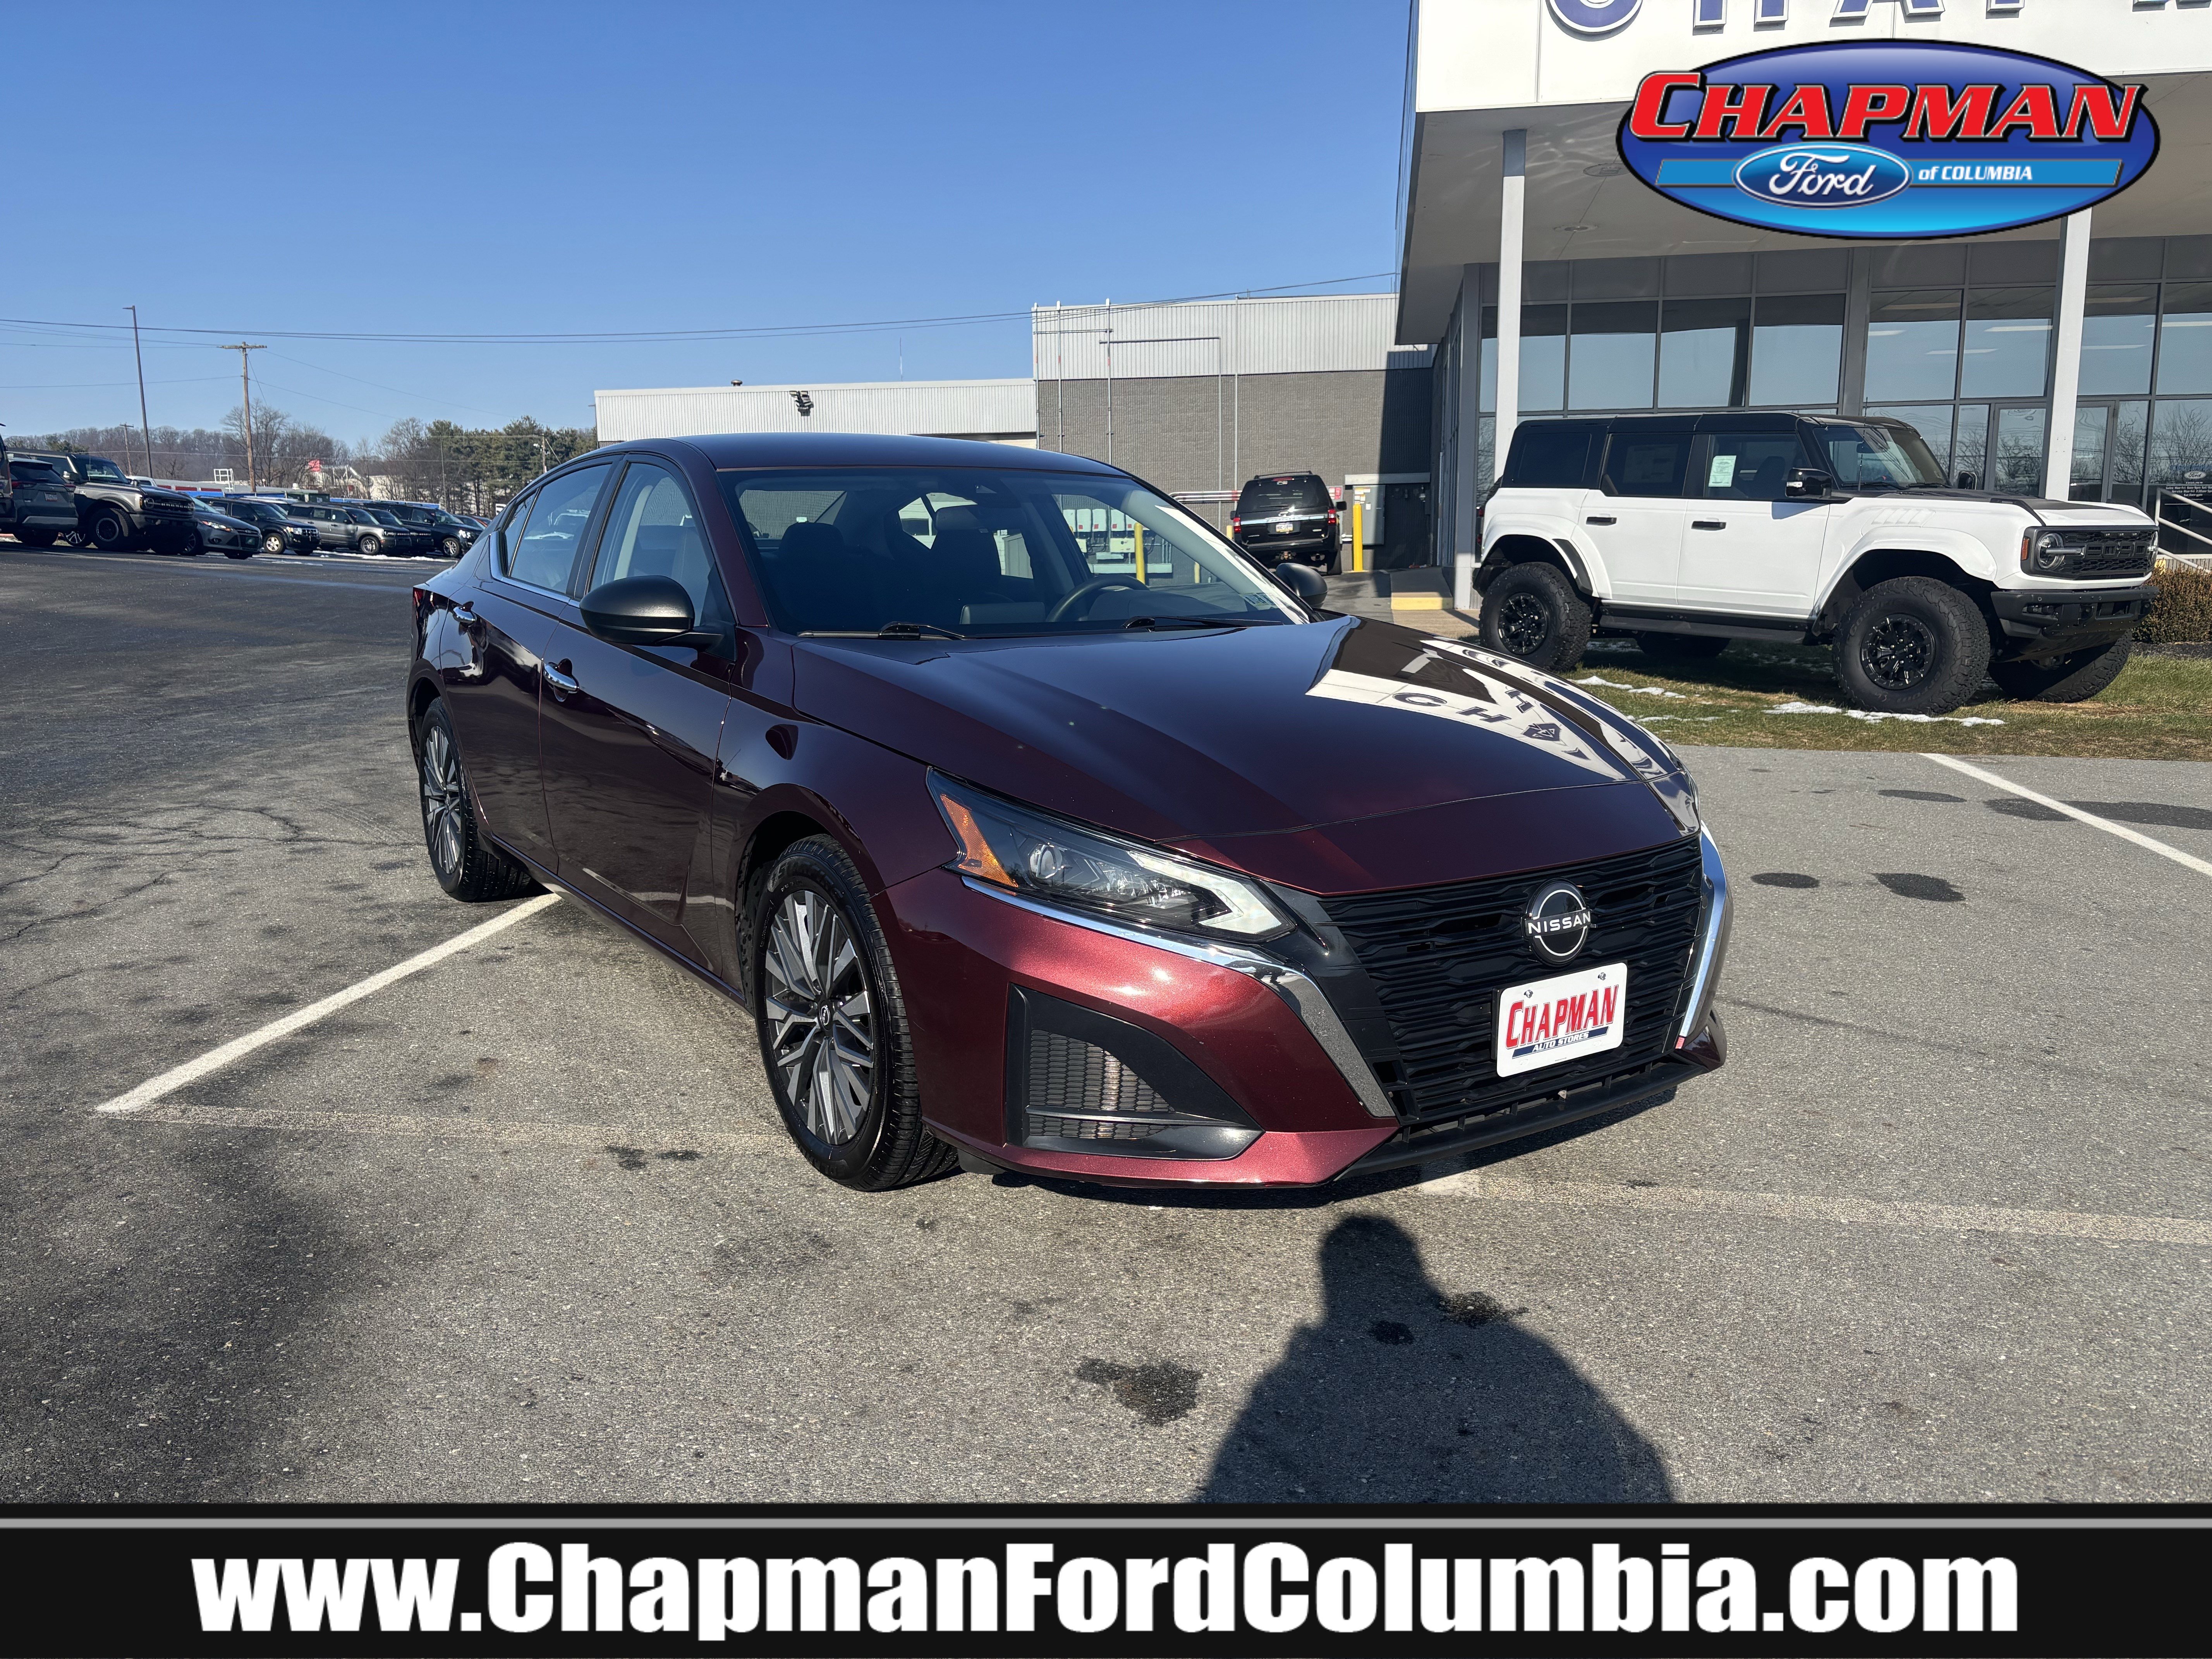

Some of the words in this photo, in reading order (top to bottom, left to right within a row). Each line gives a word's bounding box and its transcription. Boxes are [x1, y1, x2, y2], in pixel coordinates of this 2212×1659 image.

[1528, 911, 1591, 934] NISSAN
[1505, 984, 1619, 1049] CHAPMAN
[1532, 1039, 1556, 1052] AUTO
[1557, 1031, 1589, 1047] STORES
